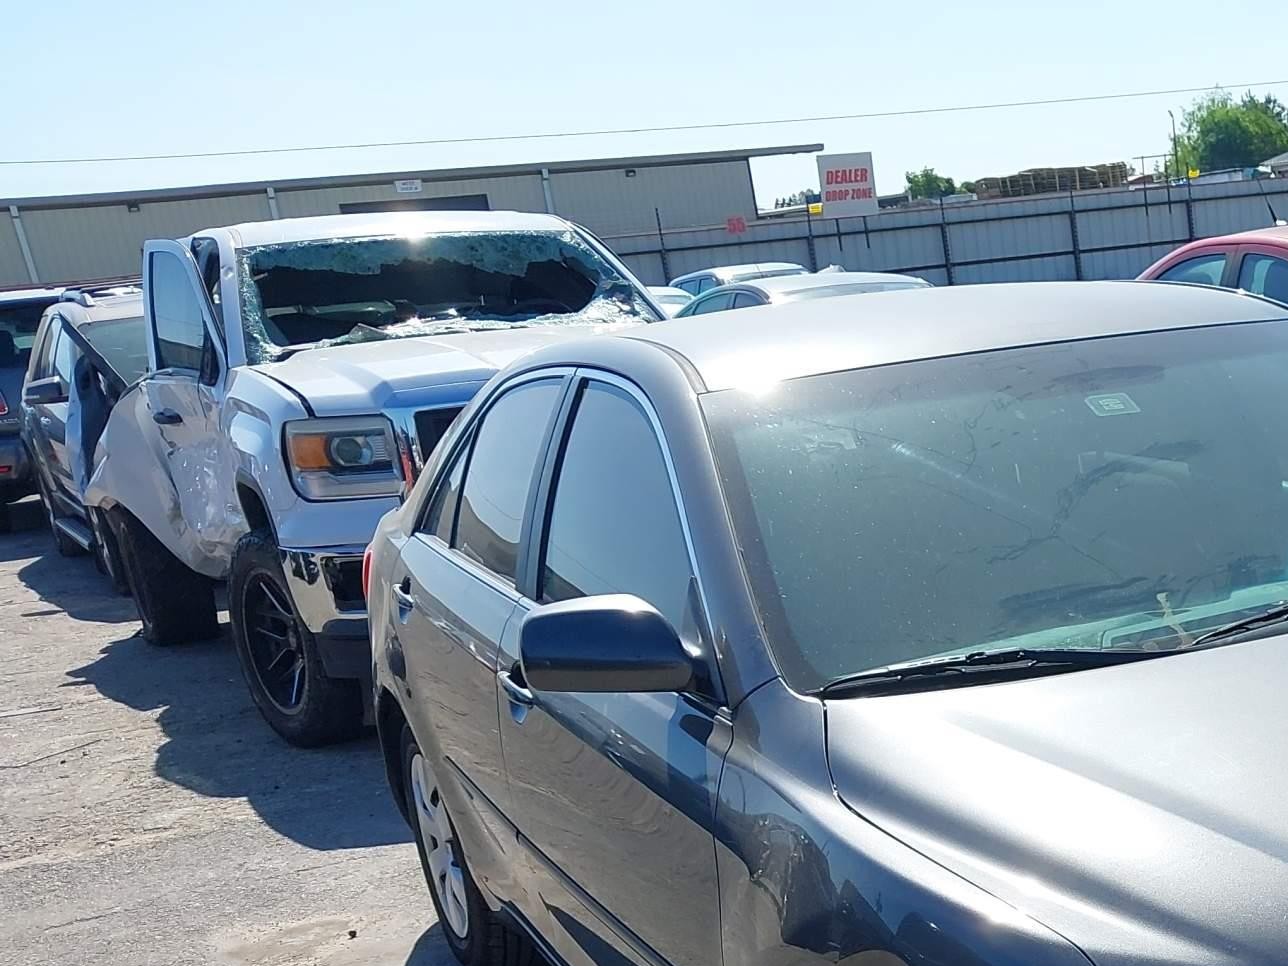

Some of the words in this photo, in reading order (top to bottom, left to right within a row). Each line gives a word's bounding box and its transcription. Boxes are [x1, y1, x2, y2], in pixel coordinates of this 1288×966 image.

[826, 167, 868, 185] DEALER
[825, 188, 850, 202] DROP
[850, 187, 873, 200] ZONE
